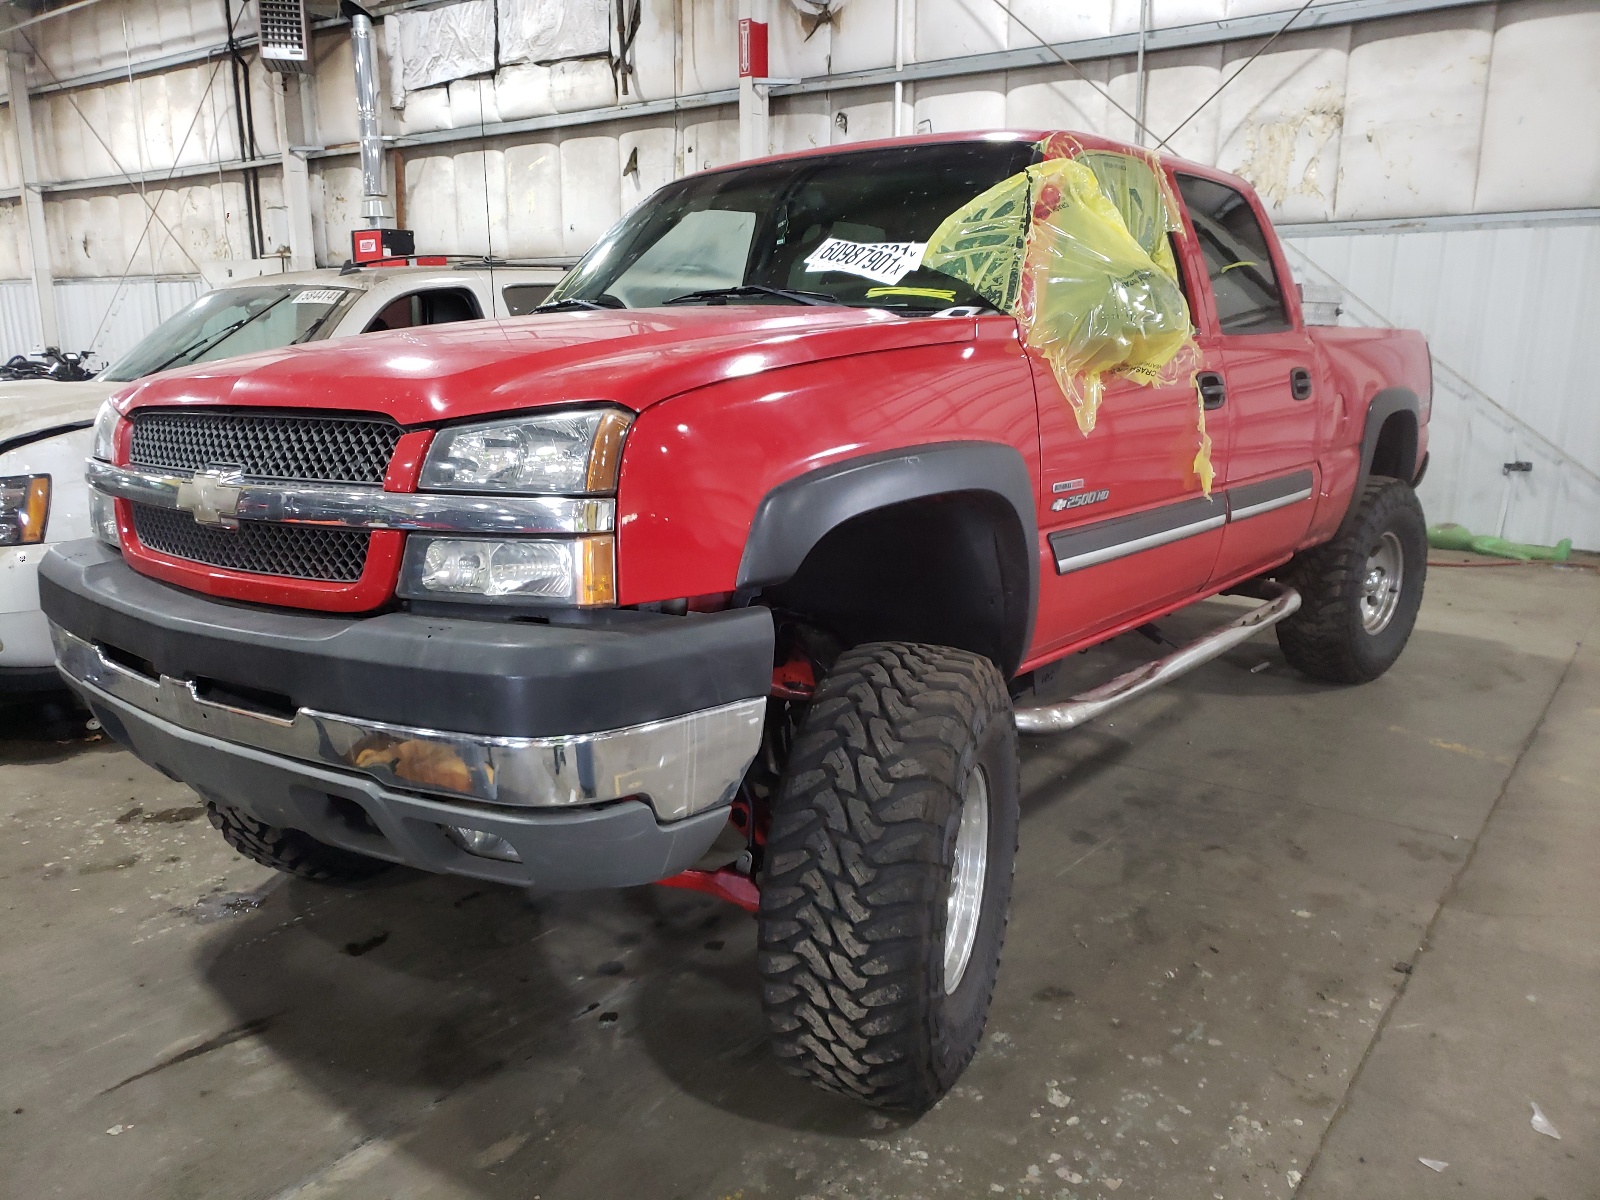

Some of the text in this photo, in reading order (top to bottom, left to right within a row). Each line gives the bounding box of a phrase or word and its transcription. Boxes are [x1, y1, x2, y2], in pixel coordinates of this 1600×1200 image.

[820, 241, 902, 274] 60987901
[1066, 489, 1110, 509] 2500 HD
